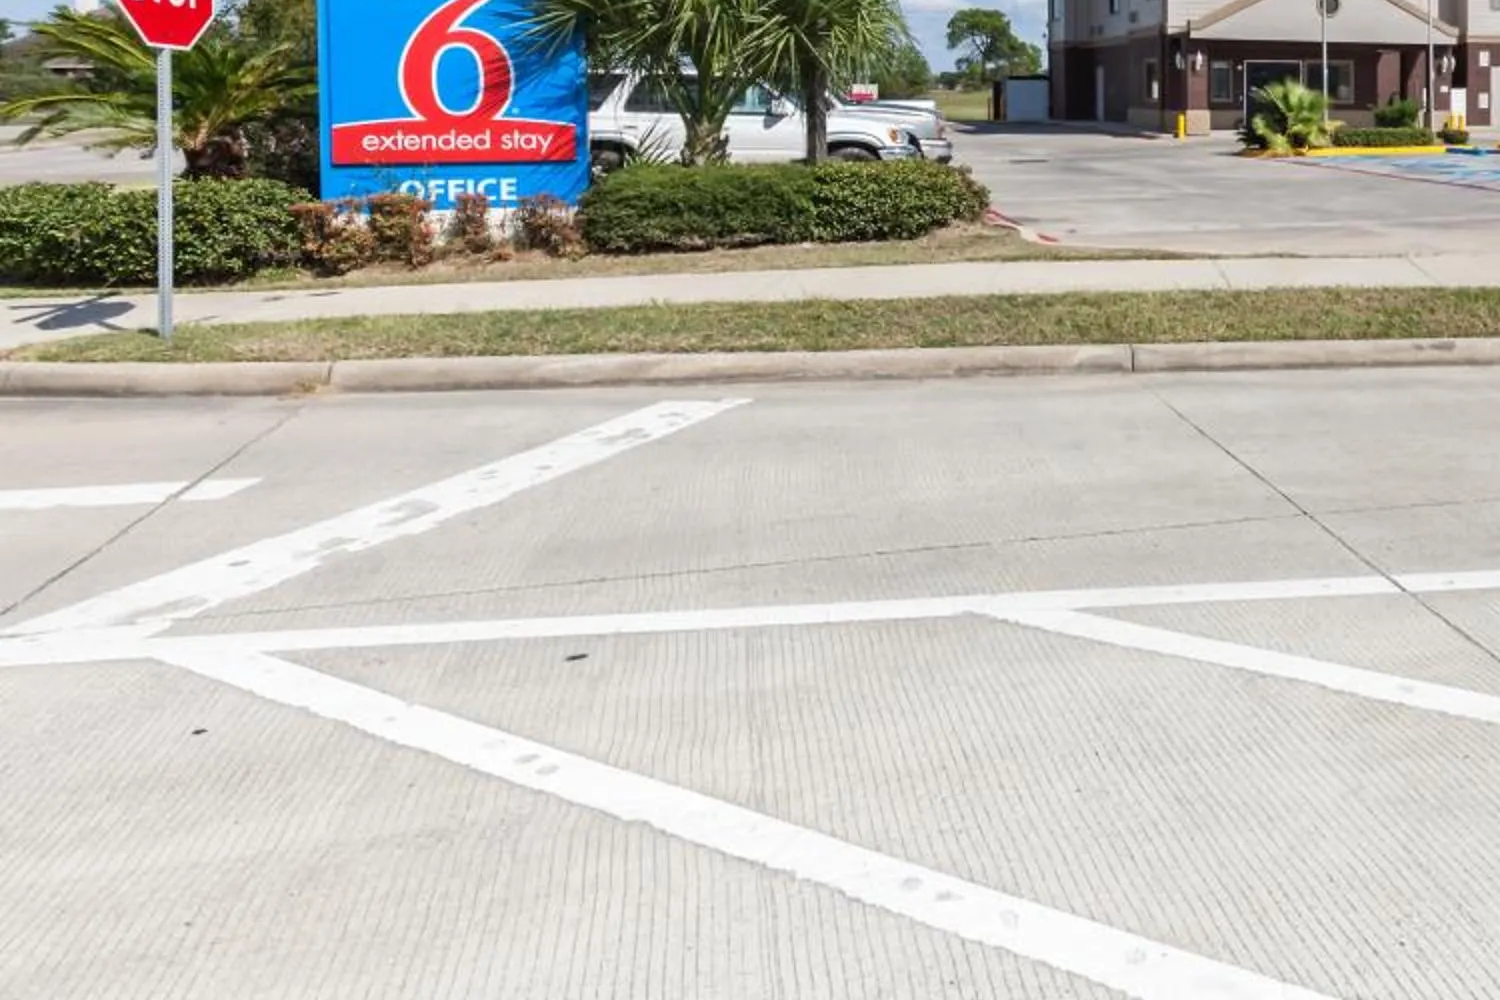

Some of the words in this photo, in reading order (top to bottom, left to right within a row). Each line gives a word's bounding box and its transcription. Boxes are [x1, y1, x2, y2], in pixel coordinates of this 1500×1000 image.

[362, 130, 490, 152] extended
[501, 131, 553, 153] stay
[400, 177, 518, 202] OFFICE
